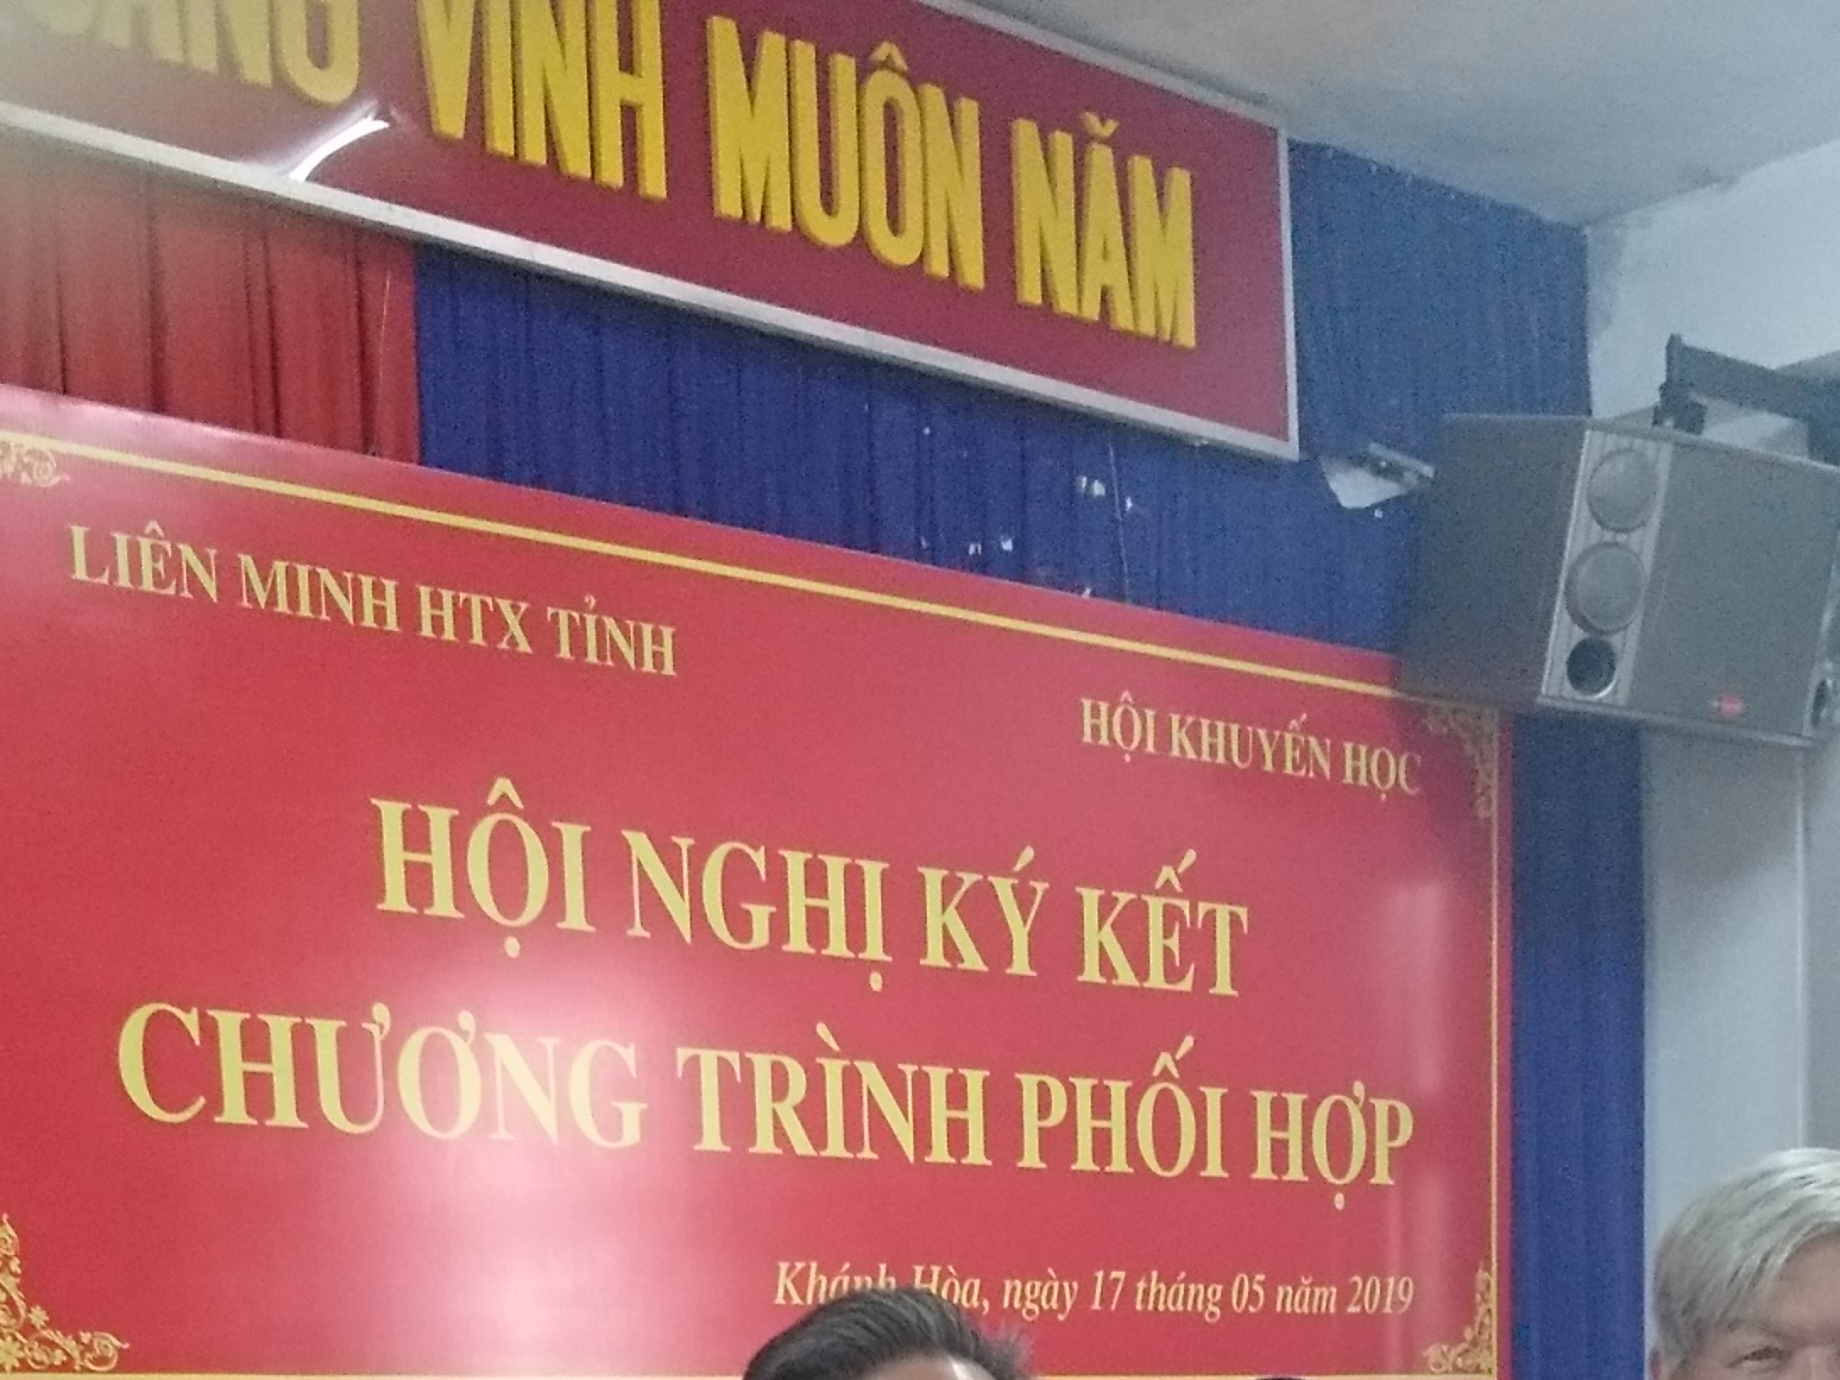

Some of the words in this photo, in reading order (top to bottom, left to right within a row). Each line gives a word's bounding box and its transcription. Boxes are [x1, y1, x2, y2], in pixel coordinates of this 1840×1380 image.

[706, 14, 985, 290] MUÔN
[1010, 110, 1197, 350] NĂM
[69, 521, 218, 602] LIÊN
[238, 554, 400, 632] MINH
[416, 585, 534, 655] HTX
[547, 596, 677, 677] TỈNH
[1081, 691, 1158, 763] HỘI
[1168, 713, 1332, 781] KHUYẾN
[1342, 742, 1422, 802] HỌC
[370, 777, 596, 959] HỘI
[620, 829, 892, 994] NGHỊ
[917, 845, 1050, 977] KÝ
[1076, 848, 1249, 997] KẾT
[117, 1002, 648, 1150] CHƯƠNG
[676, 1022, 993, 1167] TRÌNH
[1013, 1036, 1230, 1179] PHỐI
[1249, 1080, 1415, 1210] HỢP
[1002, 1267, 1079, 1322] ngày
[1090, 1269, 1126, 1311] 17
[1134, 1270, 1224, 1324] tháng
[1231, 1273, 1266, 1314] 05
[1275, 1275, 1338, 1315] năm
[1347, 1274, 1414, 1315] 2019
